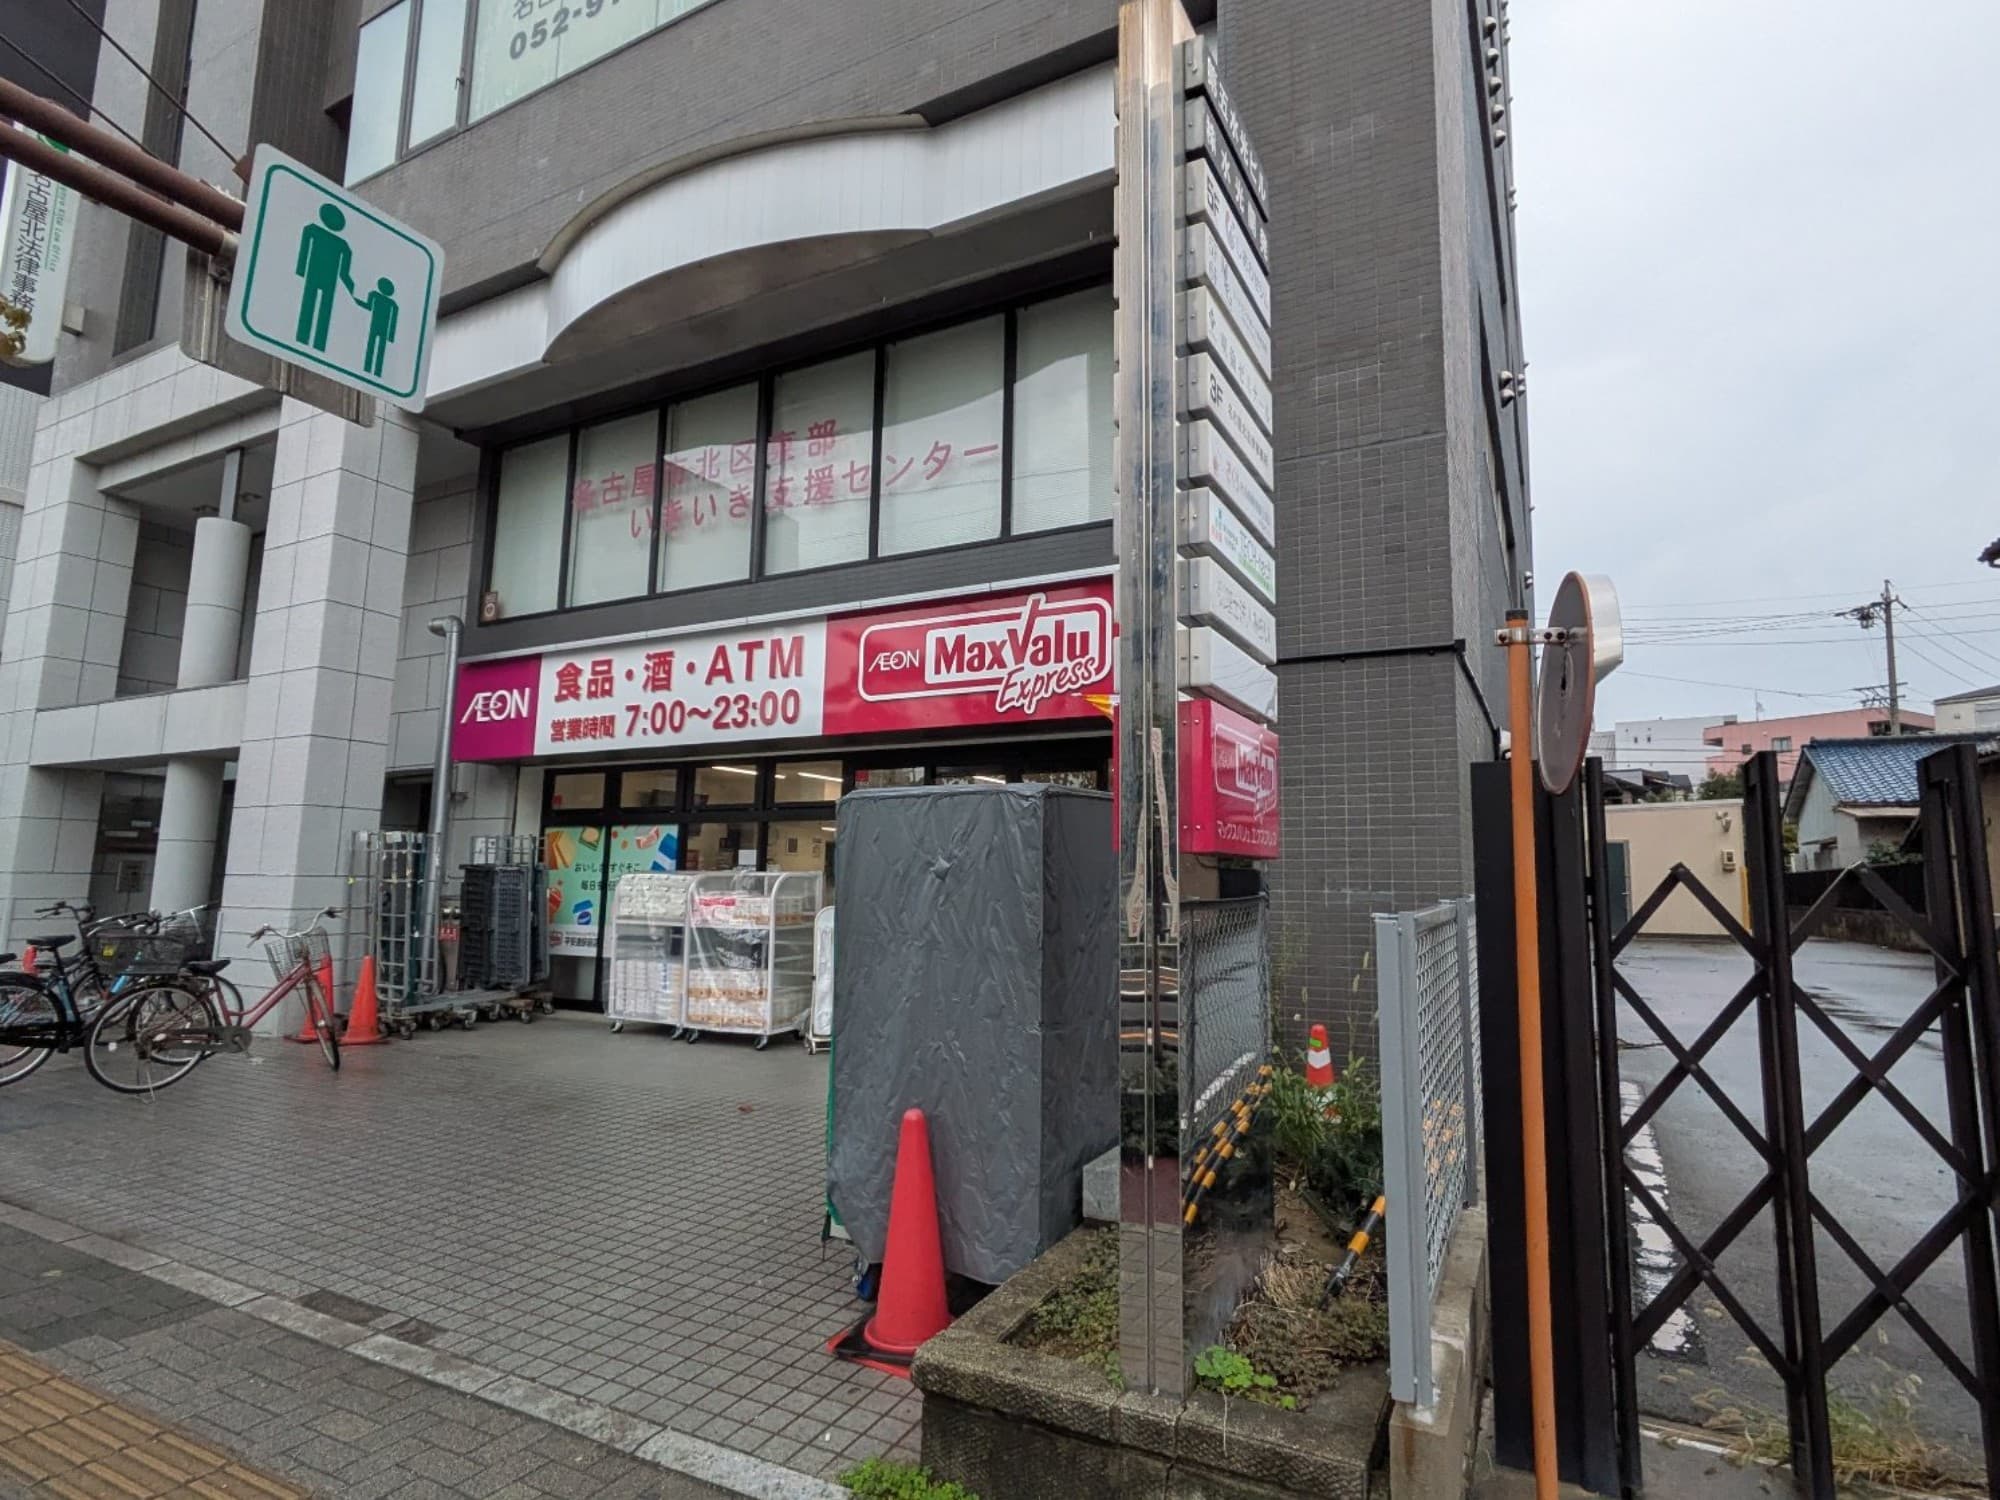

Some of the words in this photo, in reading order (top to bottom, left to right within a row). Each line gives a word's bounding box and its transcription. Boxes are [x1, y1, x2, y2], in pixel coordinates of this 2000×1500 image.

[510, 0, 620, 60] 052-9
[1207, 175, 1220, 215] 5F
[9, 171, 52, 314] 名古屋北法律事務
[1209, 372, 1224, 409] 3F
[933, 598, 1091, 676] MaxValu
[998, 655, 1096, 712] Express
[550, 714, 616, 743] 営業時間
